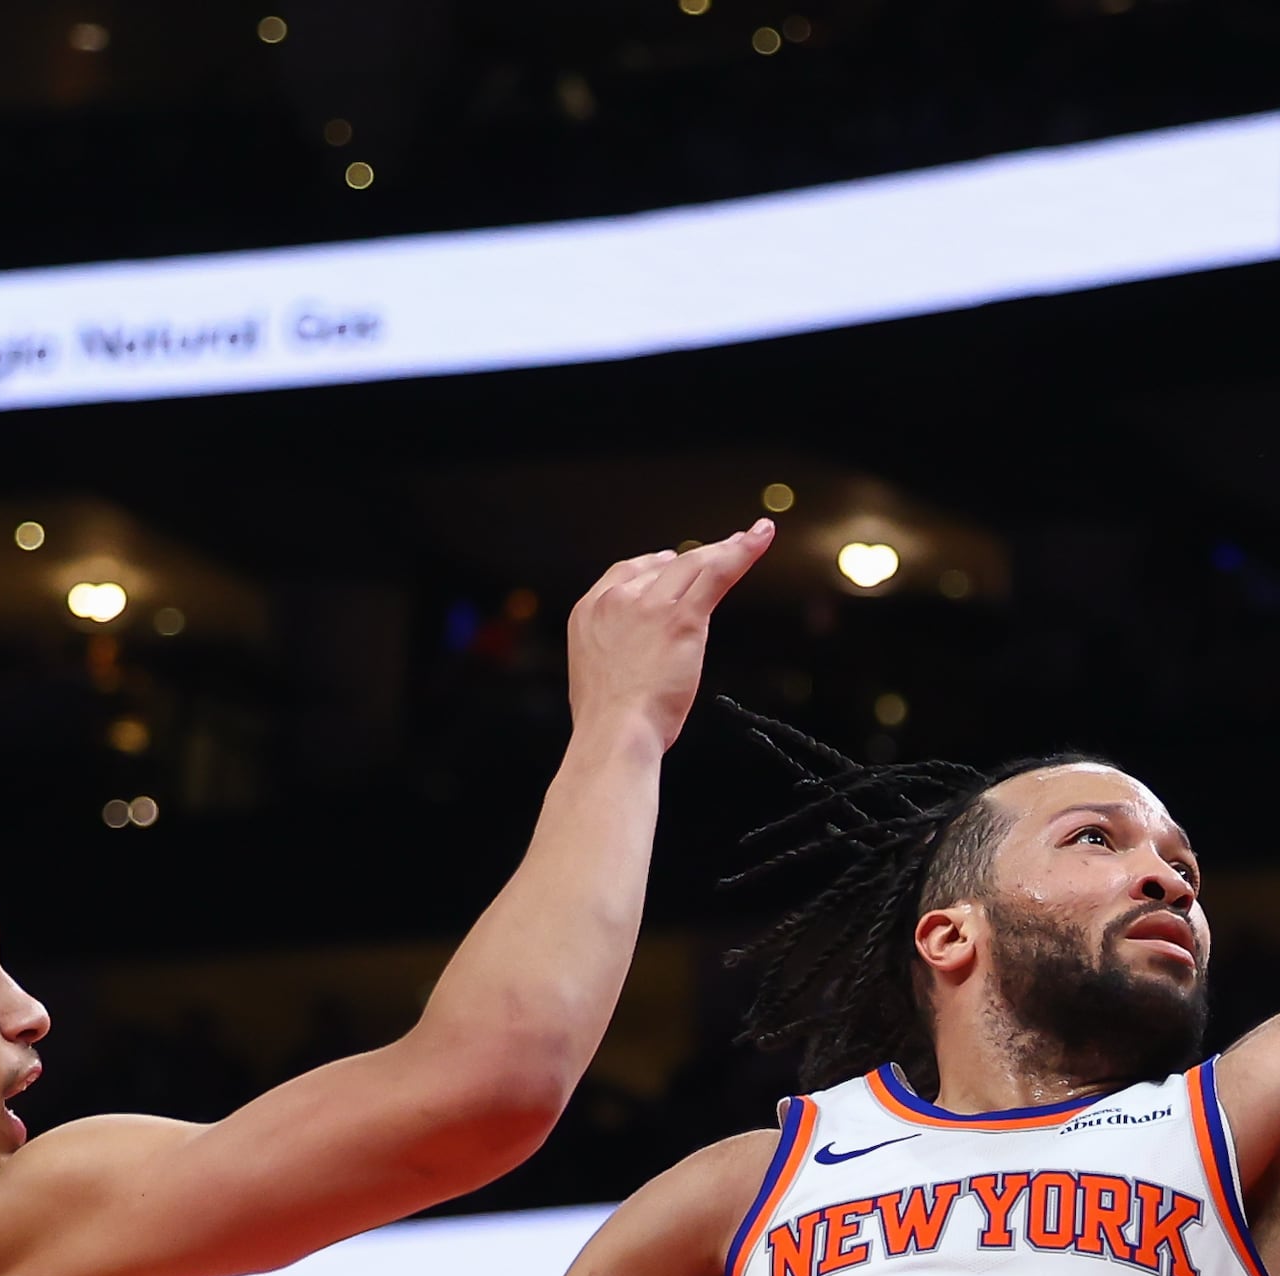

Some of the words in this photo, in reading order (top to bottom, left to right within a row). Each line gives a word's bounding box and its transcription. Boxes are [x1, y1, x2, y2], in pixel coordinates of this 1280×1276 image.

[78, 320, 260, 358] Natural
[294, 310, 382, 344] Gas
[1060, 1118, 1102, 1135] abu
[1106, 1105, 1172, 1125] dhabi
